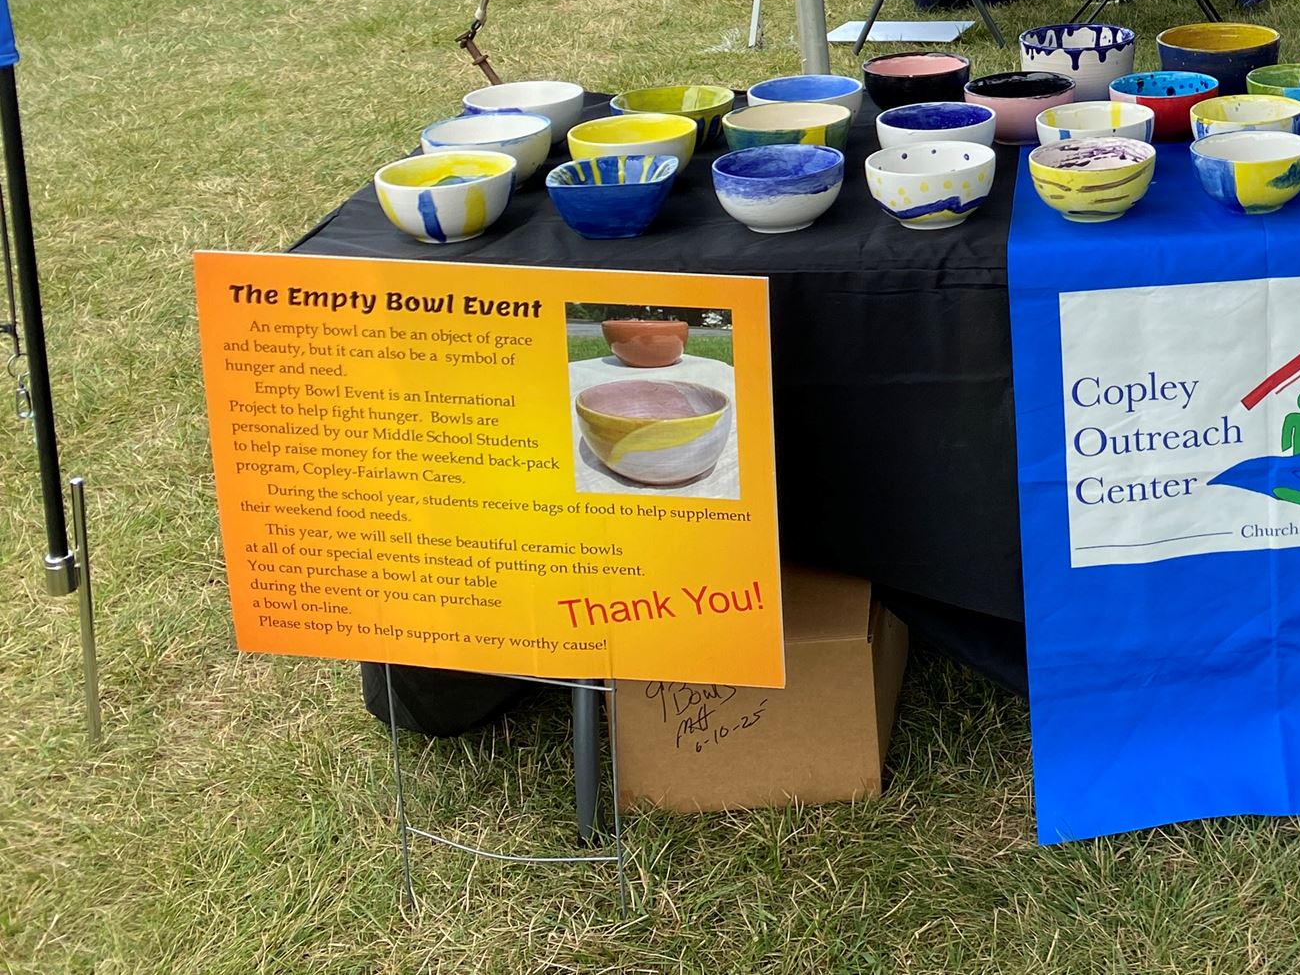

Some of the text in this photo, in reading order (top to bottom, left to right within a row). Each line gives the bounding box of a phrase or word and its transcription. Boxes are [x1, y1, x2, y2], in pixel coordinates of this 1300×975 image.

[229, 283, 542, 318] The Empty Bowl Event
[249, 320, 533, 349] An empty bowl can be an object of grace
[223, 339, 516, 367] and beauty, but it can also be a symbol of
[225, 358, 347, 377] hunger and need.
[255, 381, 516, 407] Empty Bowl Event is an International
[1070, 371, 1200, 413] Copley
[229, 399, 499, 426] Project to help fight hunger. Bowls are
[231, 422, 539, 449] personalized by our Middle School Students
[1072, 416, 1244, 458] Outreach
[233, 439, 560, 472] to help raise money for the weekend back-pack
[236, 461, 466, 484] program, Copley-Fairlawn Cares.
[267, 483, 751, 523] During the school year, students receive bags of food to help supplement
[1074, 473, 1198, 506] Center
[240, 500, 411, 521] their weekend food needs.
[264, 523, 623, 556] This year, we will sell these beautiful ceramic bowls
[1240, 521, 1300, 539] Church
[245, 541, 645, 577] at all of our special events instead of putting on this event.
[247, 559, 498, 588] You can purchase a bowl at our table
[250, 577, 502, 608] during the event or you can purchase
[252, 596, 352, 614] a bowl on-line.
[558, 581, 764, 628] Thank You!
[258, 615, 607, 654] Please stop by to help support a very worthy cause!
